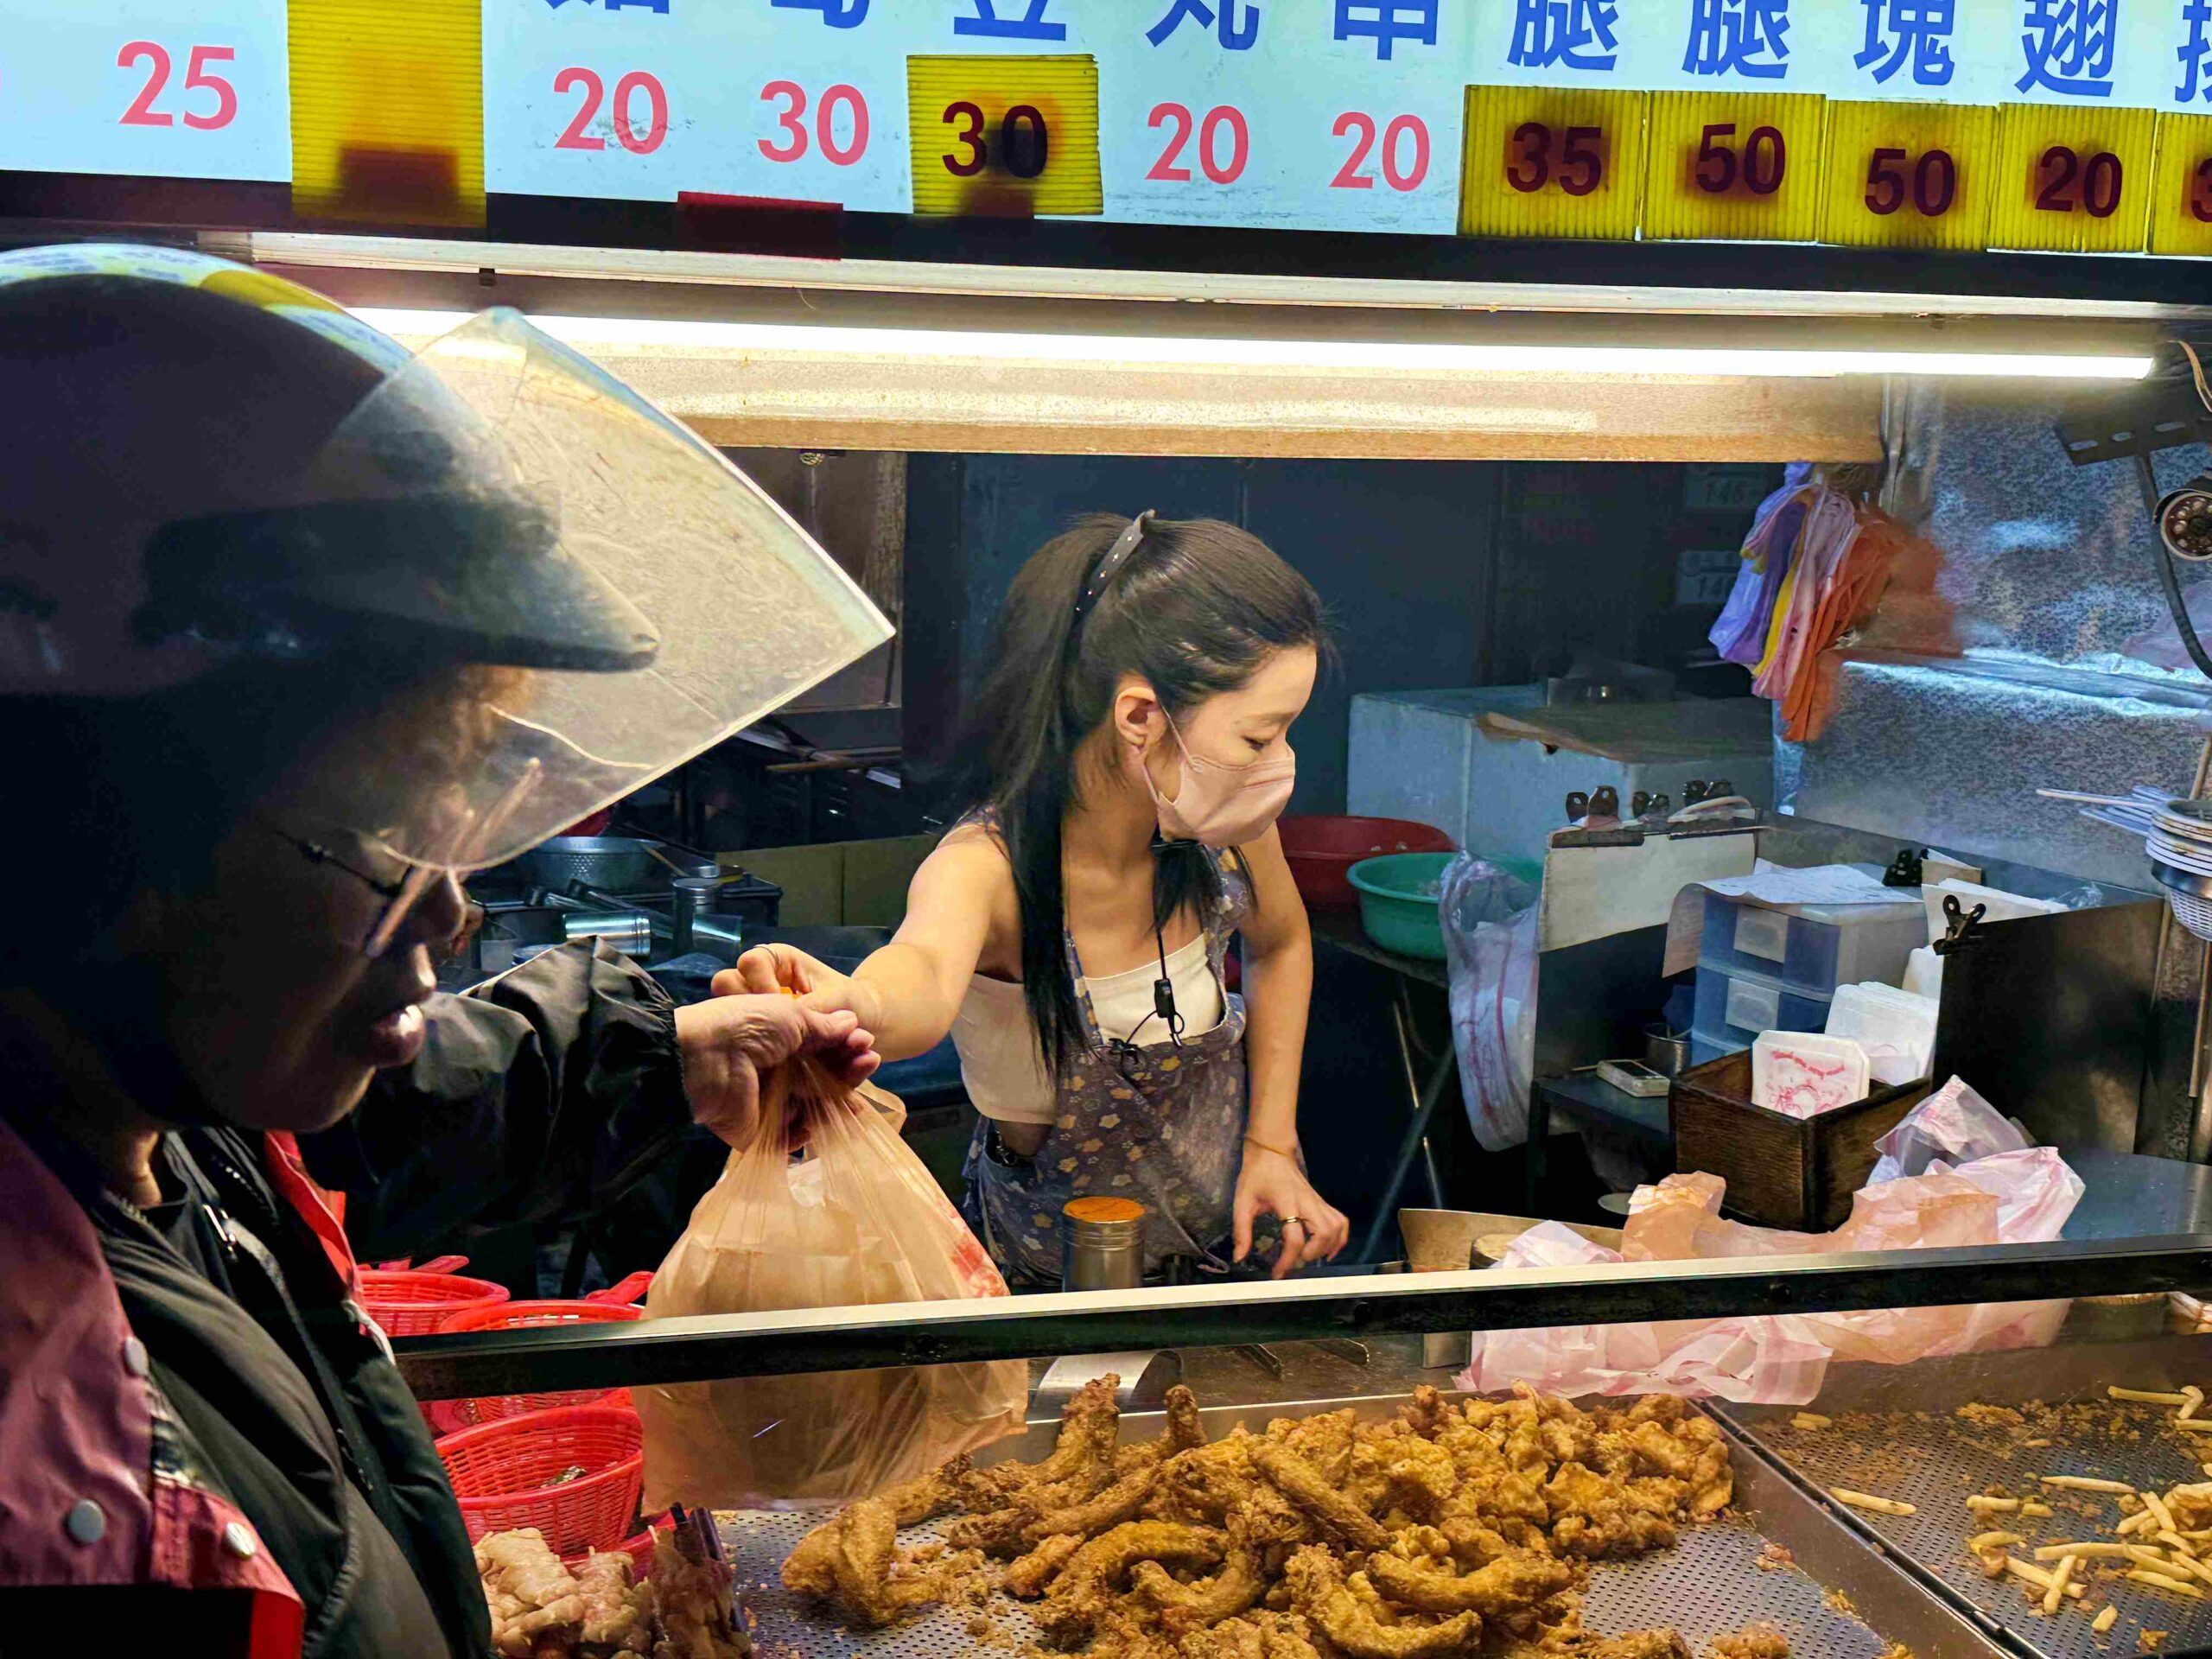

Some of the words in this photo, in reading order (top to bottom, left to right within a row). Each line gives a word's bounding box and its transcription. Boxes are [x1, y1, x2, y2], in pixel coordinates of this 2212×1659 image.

[1853, 0, 1955, 86] 塊
[2016, 0, 2119, 98] 翅
[118, 41, 237, 130] 25
[553, 67, 669, 156] 20
[757, 80, 869, 166] 30
[942, 100, 1048, 179] 30
[1145, 103, 1249, 185] 20
[1329, 111, 1431, 193] 20
[1506, 121, 1602, 197] 35
[1695, 123, 1786, 196] 50
[1864, 147, 1955, 218] 50
[2035, 145, 2124, 219] 20
